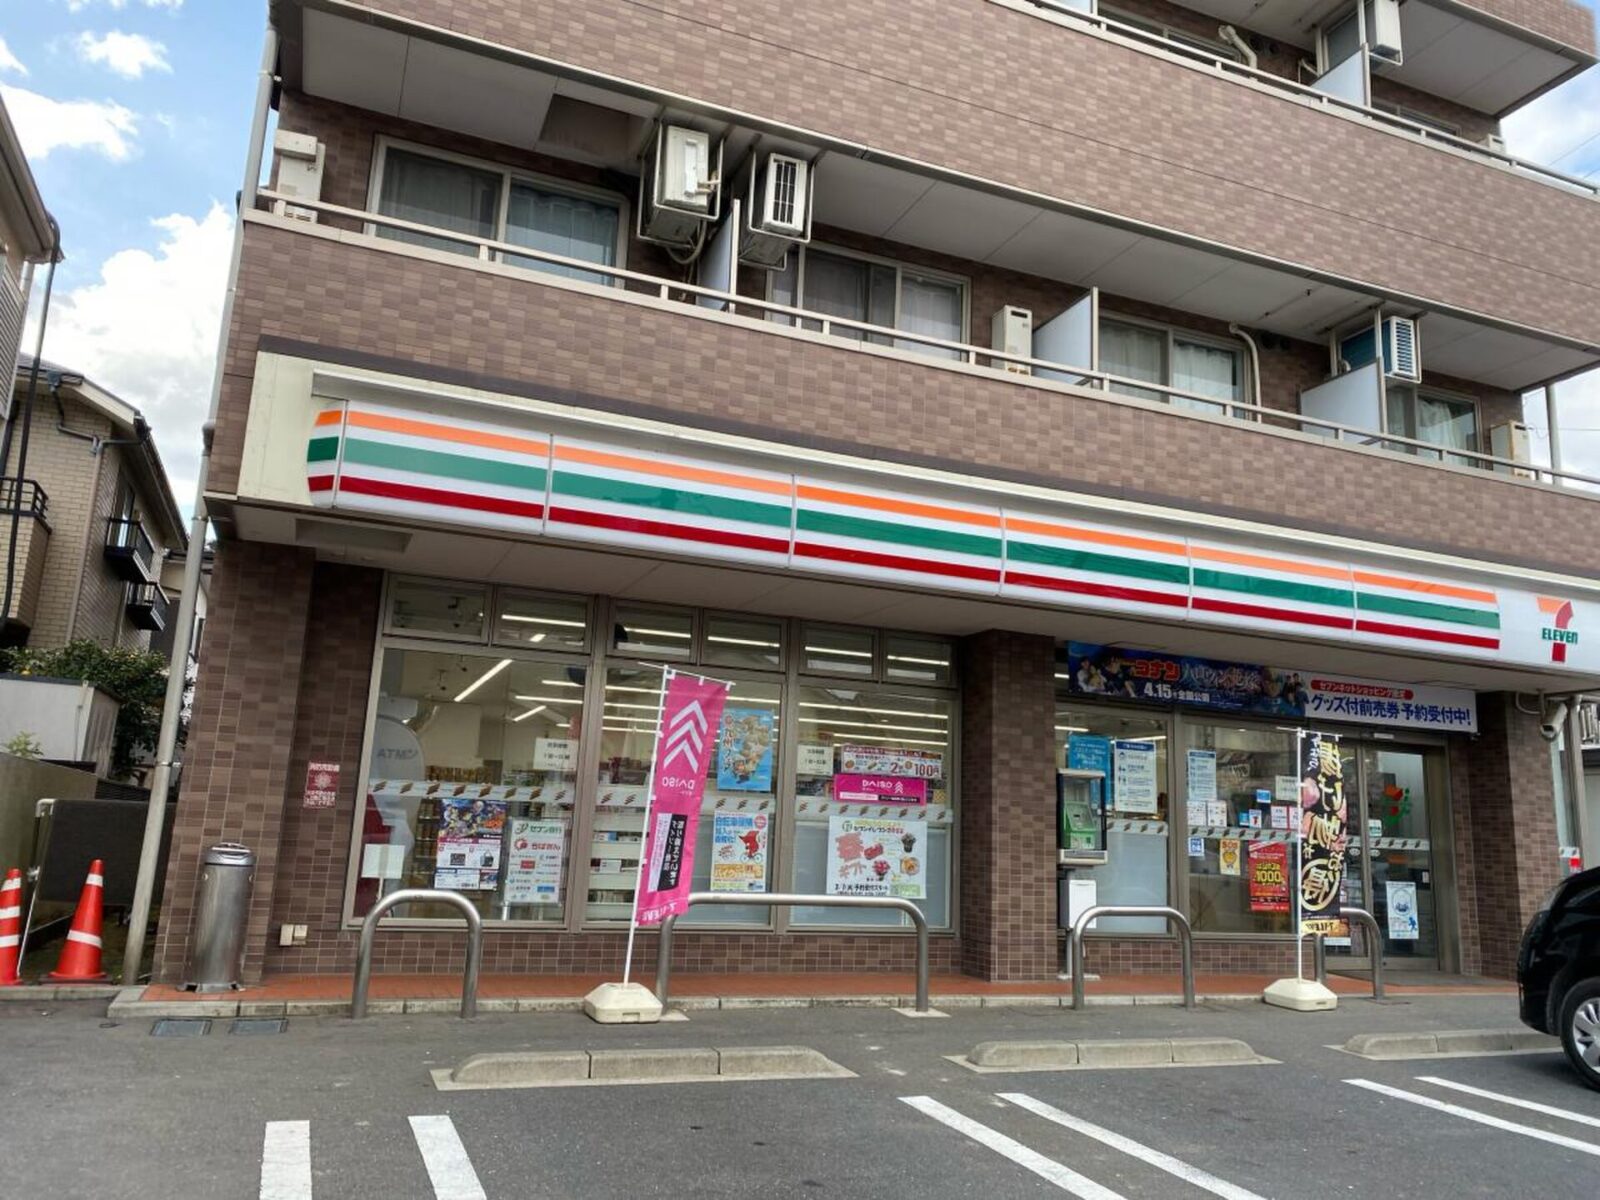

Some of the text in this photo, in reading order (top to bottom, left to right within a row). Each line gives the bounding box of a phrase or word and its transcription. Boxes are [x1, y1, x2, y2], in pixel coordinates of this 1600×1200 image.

[1134, 659, 1180, 682] コナン
[1144, 682, 1172, 699] 4.15
[1311, 694, 1400, 719] グッズ付前売券
[862, 779, 893, 789] DAISO
